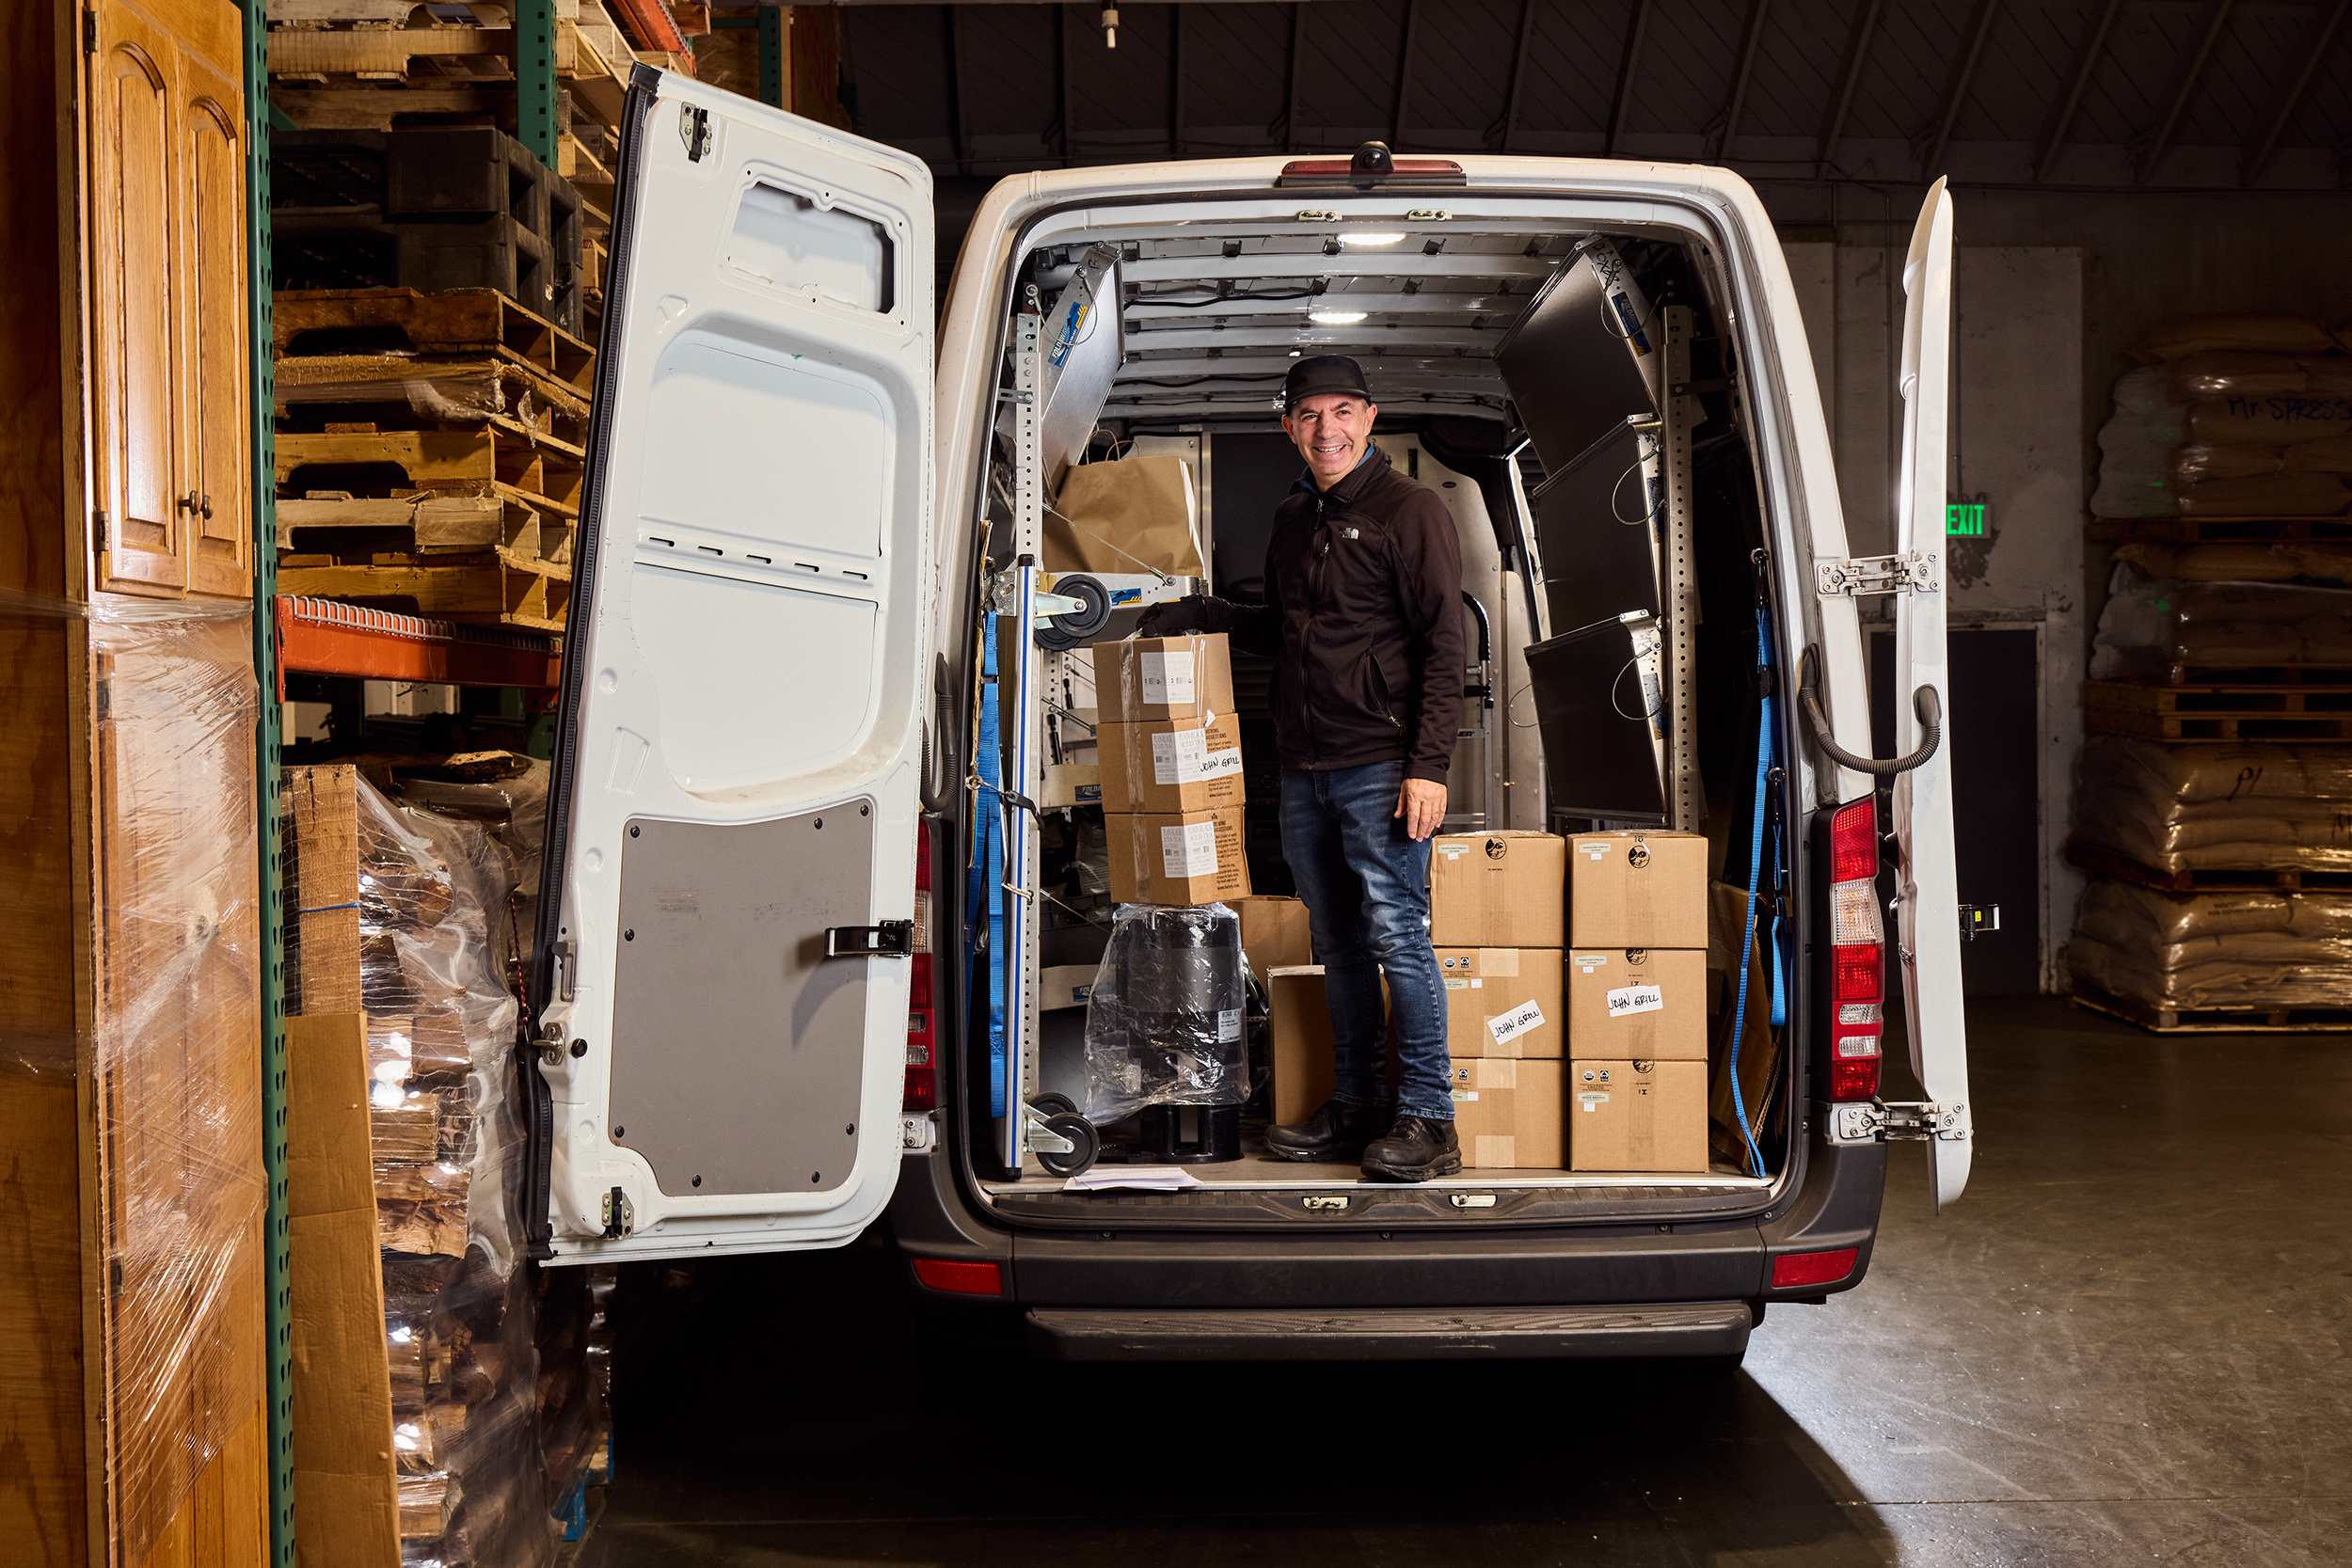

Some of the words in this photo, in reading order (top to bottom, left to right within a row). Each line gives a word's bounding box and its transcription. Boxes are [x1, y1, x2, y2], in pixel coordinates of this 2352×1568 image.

[2228, 395, 2263, 420] Mr.
[1947, 504, 1985, 535] EXIT
[1200, 756, 1218, 772] JOHN
[1221, 753, 1241, 768] GRILL
[1609, 992, 1630, 1009] JOHN
[1635, 991, 1659, 1006] GRILL
[1495, 1019, 1516, 1038] JOHN
[1518, 1009, 1540, 1026] GRILL
